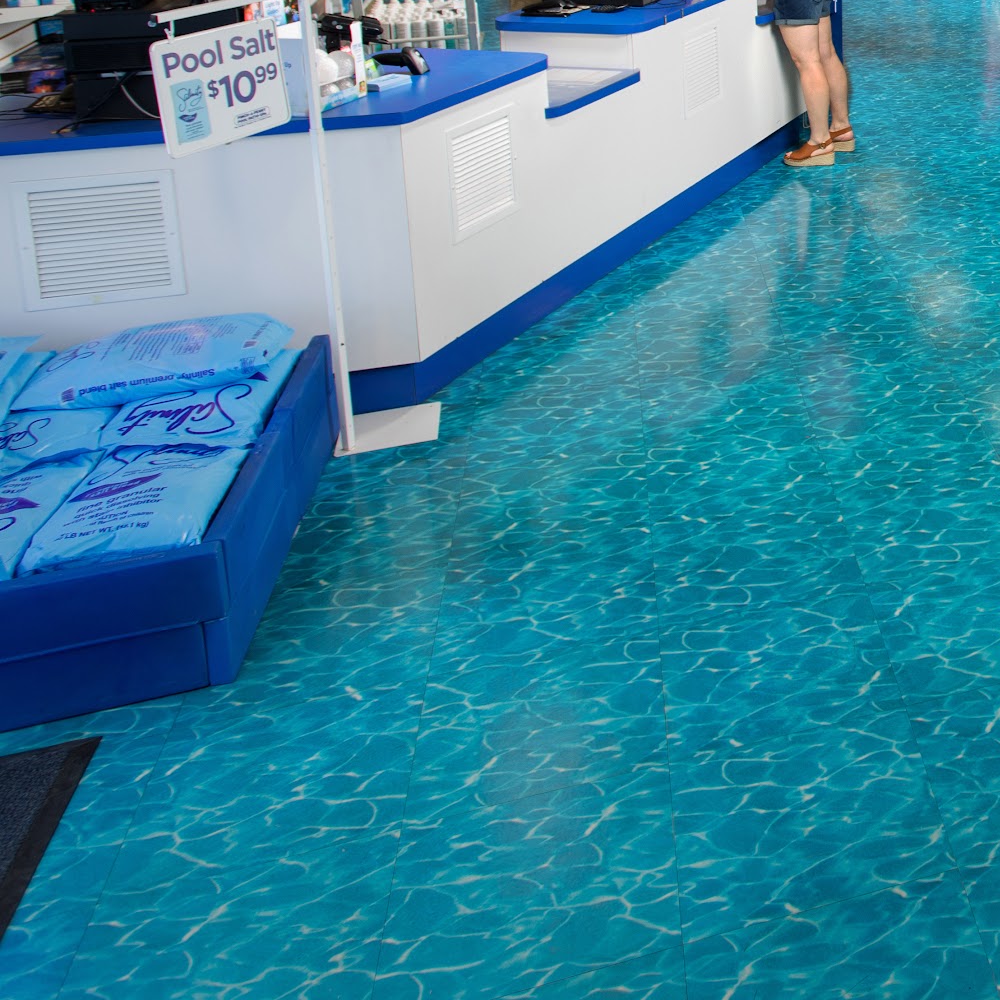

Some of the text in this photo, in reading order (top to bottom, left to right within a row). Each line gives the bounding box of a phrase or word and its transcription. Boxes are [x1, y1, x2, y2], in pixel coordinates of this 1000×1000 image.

[161, 29, 276, 79] Pool Salt
[79, 383, 107, 397] blend
[129, 375, 174, 388] premium
[118, 383, 252, 436] Salinity
